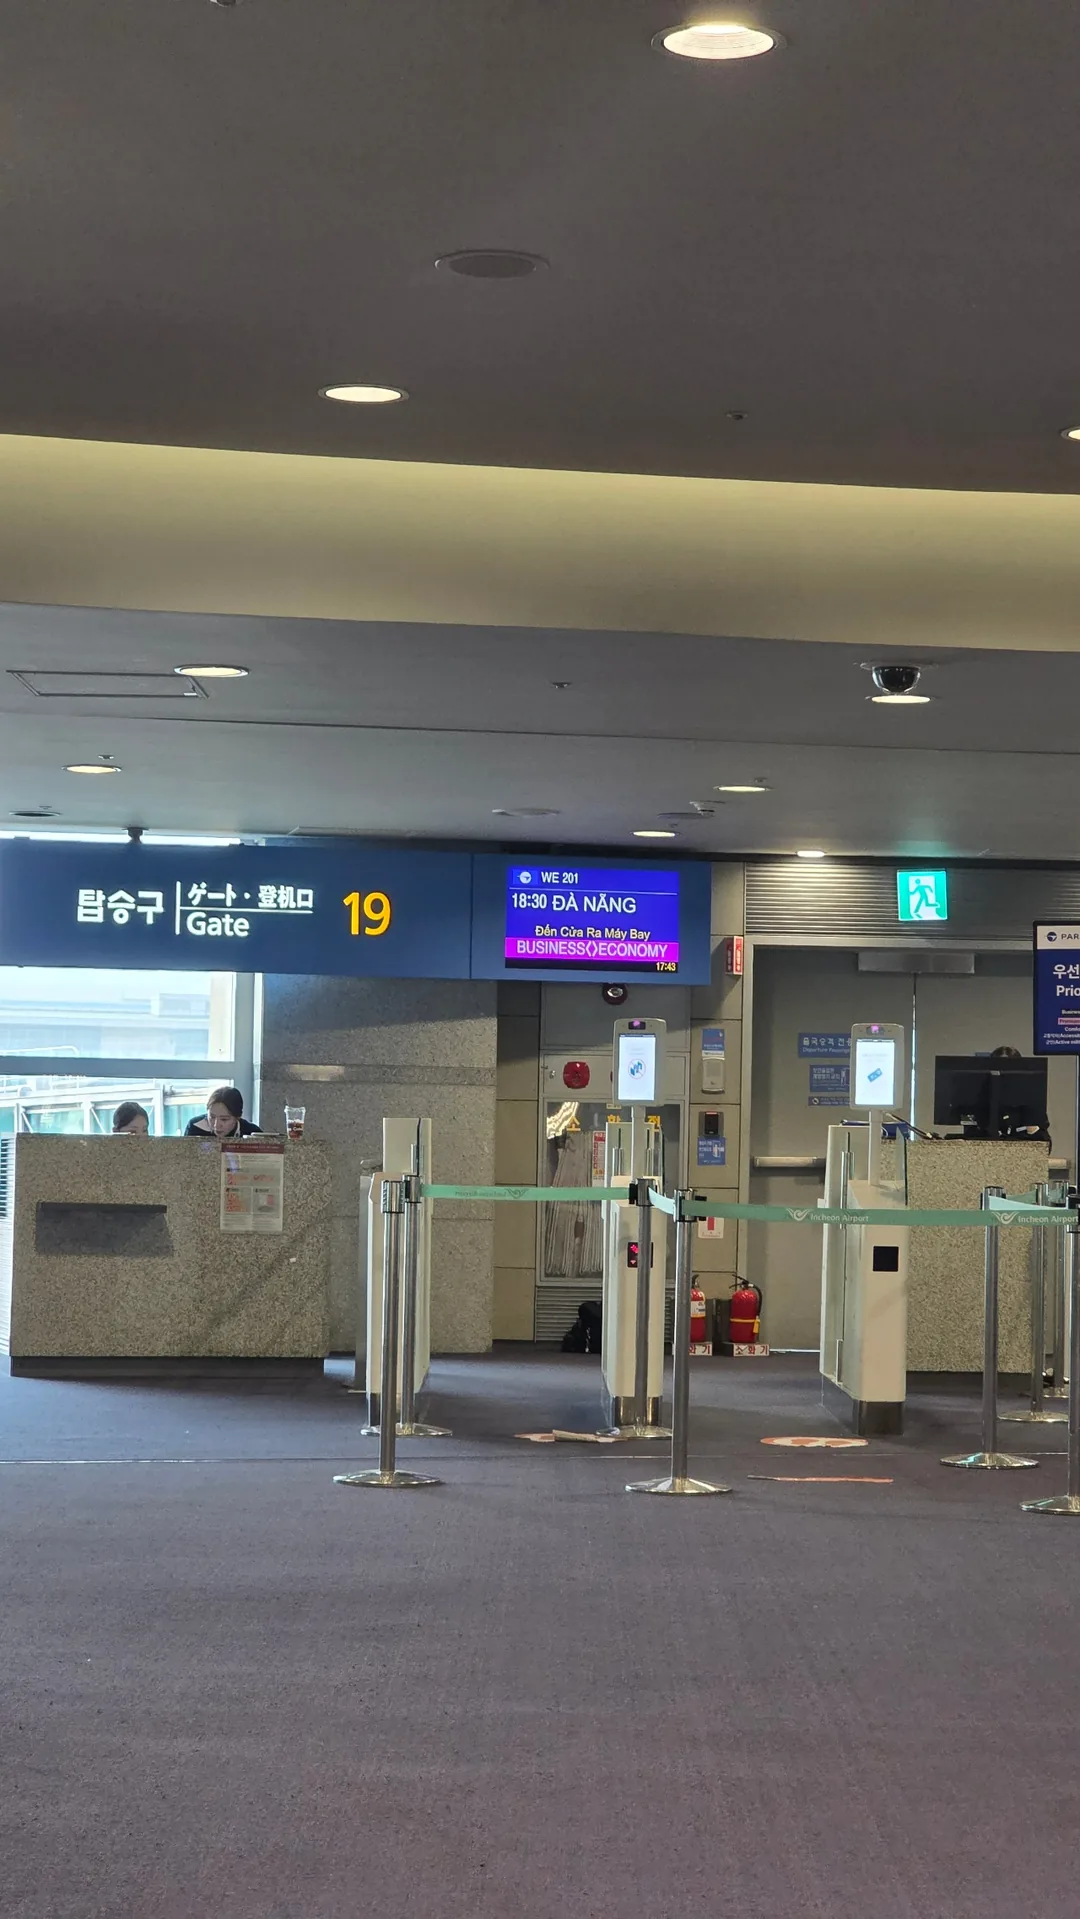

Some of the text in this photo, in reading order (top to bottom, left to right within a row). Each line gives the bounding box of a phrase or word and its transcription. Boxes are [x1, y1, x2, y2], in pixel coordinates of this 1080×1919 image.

[541, 872, 579, 884] WE 201
[77, 889, 165, 925] 탑승구
[512, 893, 547, 909] 18:30
[552, 892, 579, 912] ĐÀ
[343, 891, 391, 936] 19
[186, 911, 250, 937] Gate
[535, 923, 651, 944] Đến Cửa Ra Máy Bay
[656, 961, 676, 972] 17:43
[811, 1213, 869, 1224] Incheon Airport
[1018, 1215, 1079, 1224] Incheon Airport
